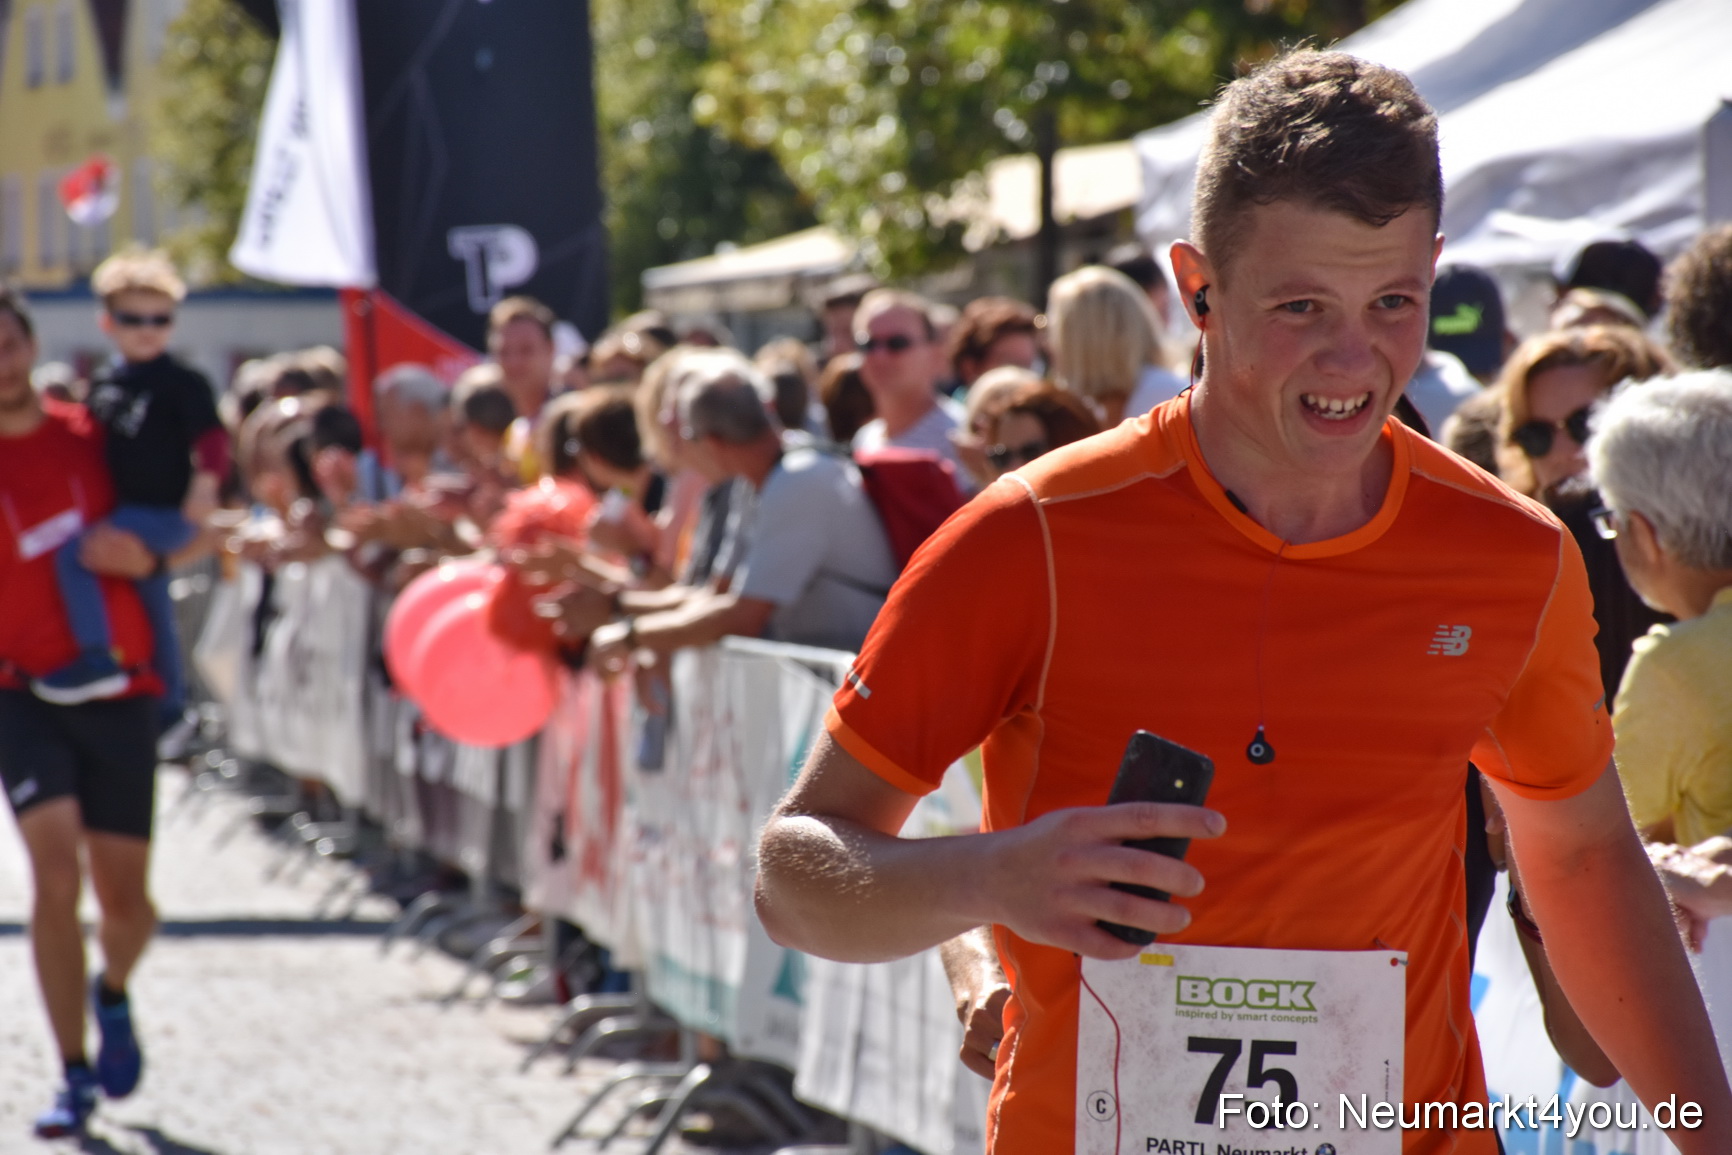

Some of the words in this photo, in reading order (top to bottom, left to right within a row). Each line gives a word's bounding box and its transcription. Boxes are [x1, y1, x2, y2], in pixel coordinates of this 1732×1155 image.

[1176, 975, 1317, 1011] BOCK
[1175, 1008, 1218, 1020] inspired
[1221, 1011, 1233, 1022] by
[1237, 1012, 1268, 1022] smart
[1271, 1013, 1318, 1024] concepts
[1187, 1036, 1298, 1129] 75
[1095, 1098, 1107, 1115] C
